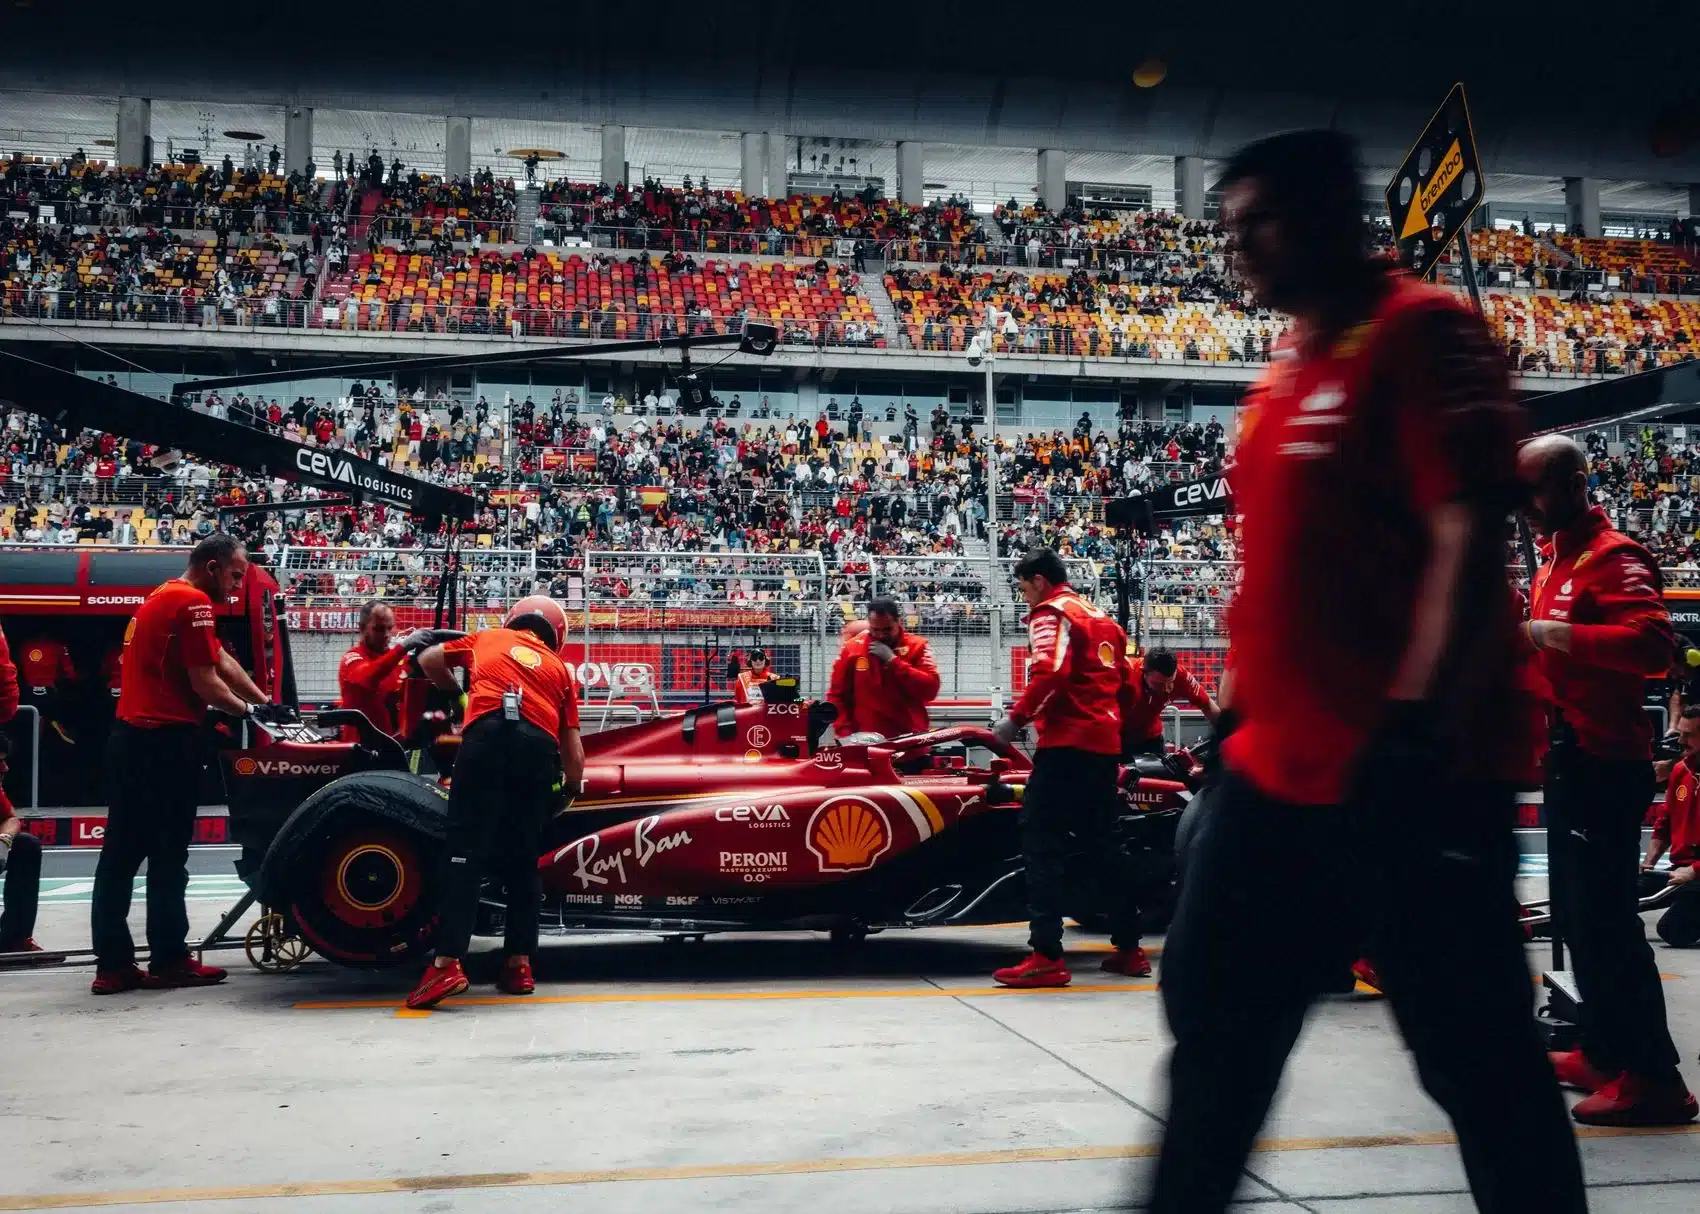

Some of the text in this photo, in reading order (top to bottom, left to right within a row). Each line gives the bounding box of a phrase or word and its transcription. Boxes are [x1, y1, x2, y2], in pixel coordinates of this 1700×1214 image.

[1420, 151, 1461, 212] brembo
[357, 474, 413, 500] LOGISTICS
[87, 596, 145, 605] SCUDERI
[767, 703, 800, 715] ZCG
[815, 751, 842, 763] aws
[257, 761, 340, 775] V-Power
[1126, 792, 1164, 803] MILLE
[719, 851, 788, 867] PERONI
[566, 894, 603, 904] MAHLE
[614, 894, 644, 905] NGK
[665, 896, 699, 905] SKF
